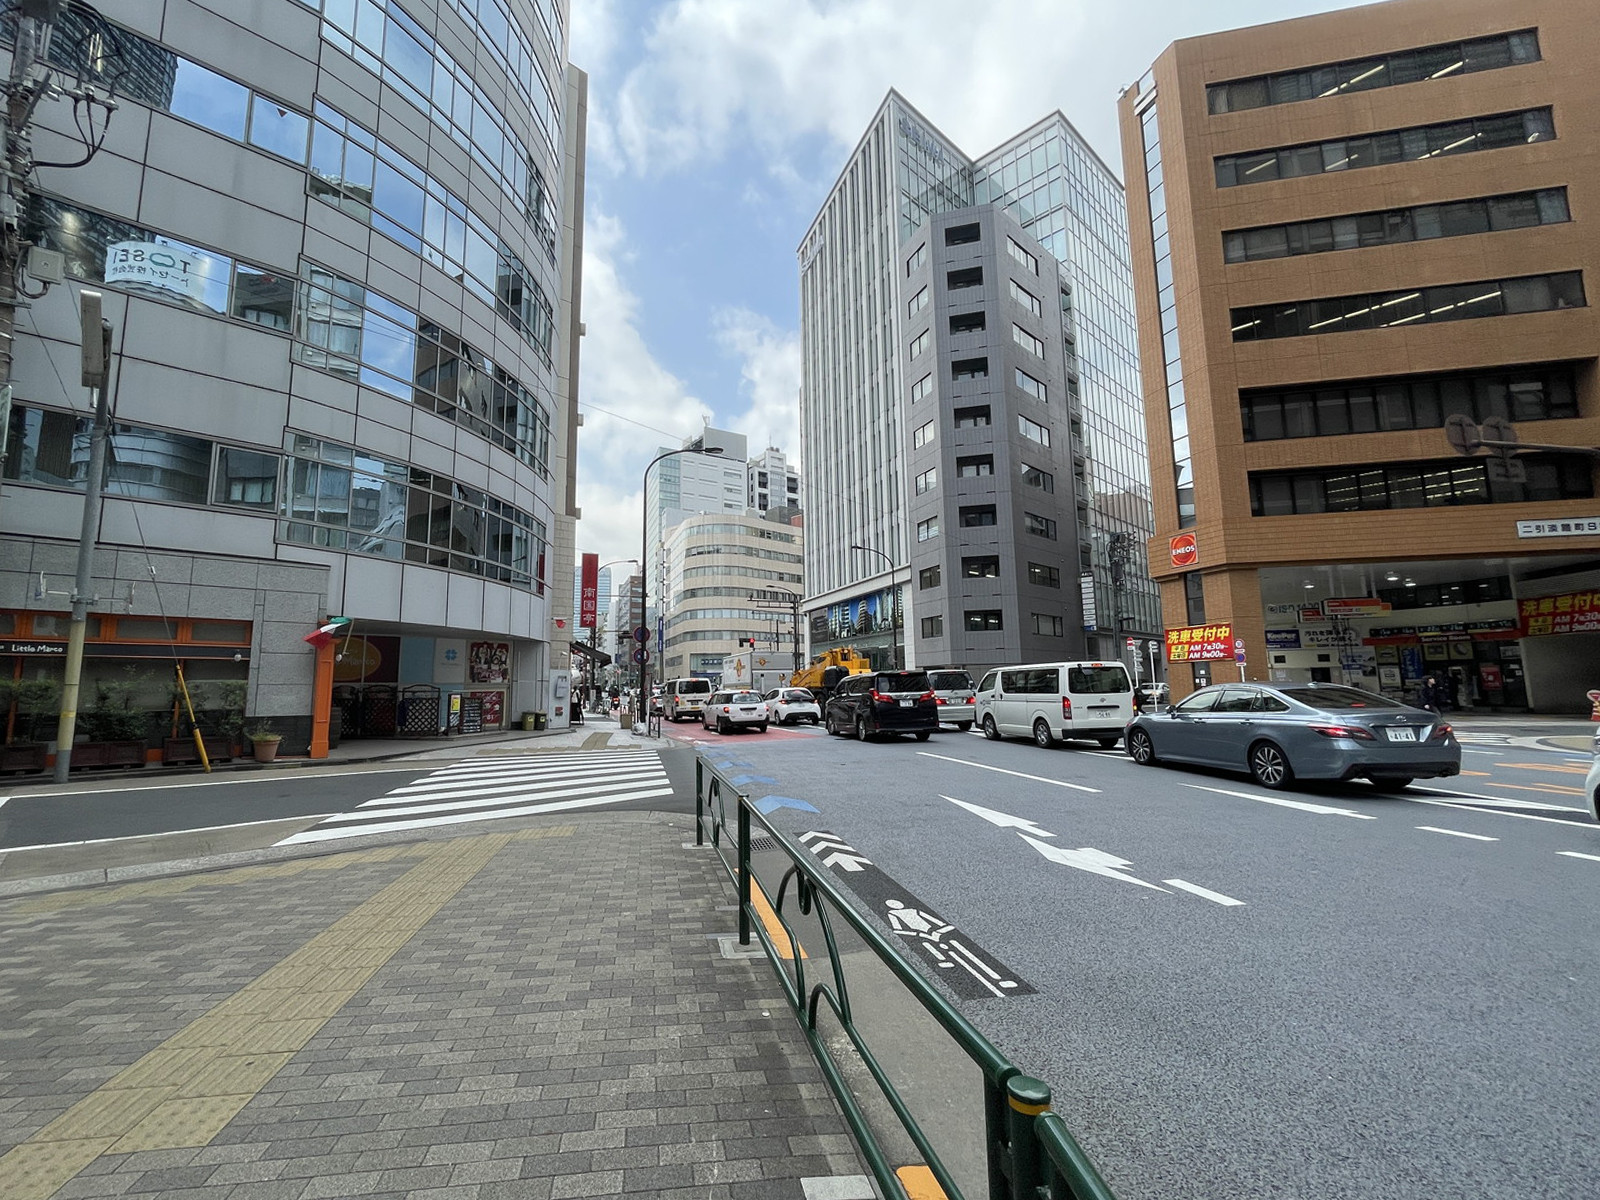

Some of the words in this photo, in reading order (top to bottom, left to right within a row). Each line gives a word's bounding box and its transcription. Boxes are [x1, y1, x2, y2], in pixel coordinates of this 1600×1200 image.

[1522, 522, 1600, 534] 二引淡路町S
[1172, 545, 1195, 556] ENEOS
[582, 587, 596, 625] 南国亭
[1167, 626, 1230, 644] 洗車受付中
[12, 644, 36, 652] Little
[37, 644, 63, 653] Marco
